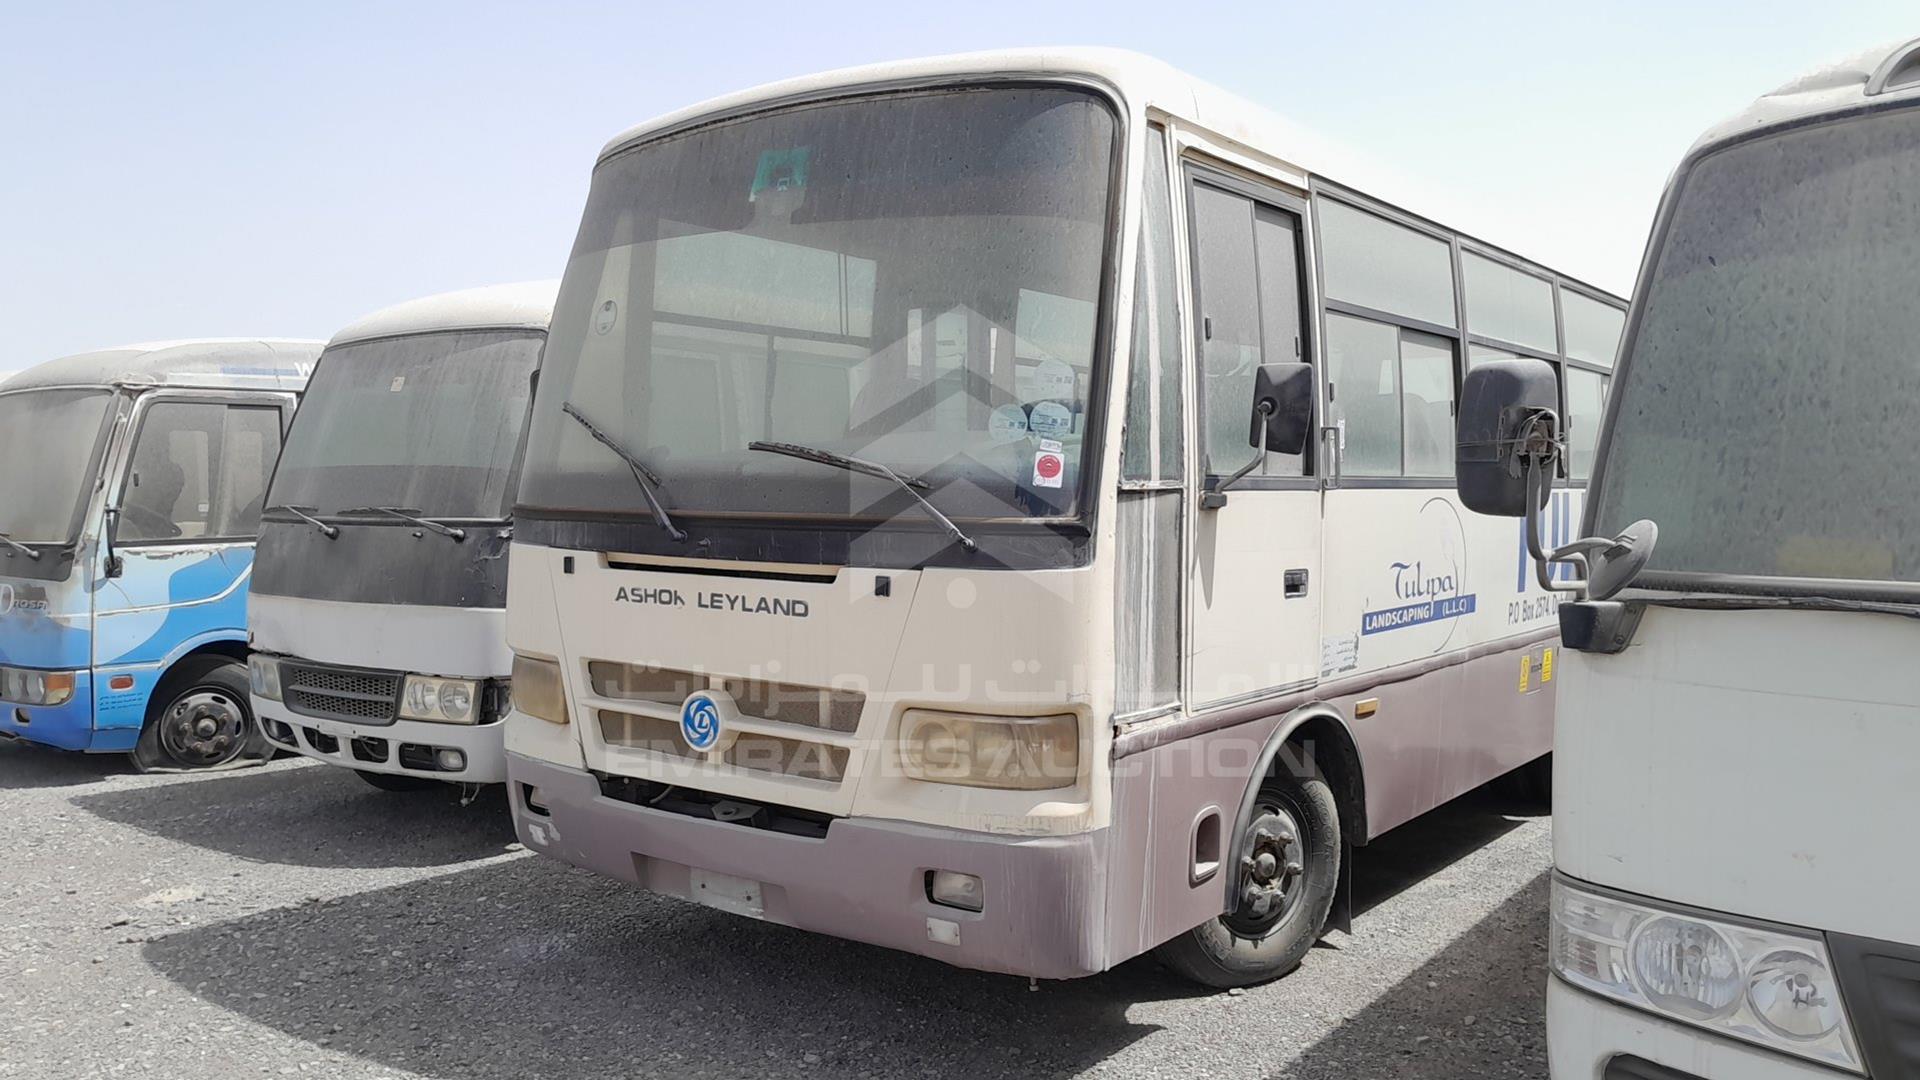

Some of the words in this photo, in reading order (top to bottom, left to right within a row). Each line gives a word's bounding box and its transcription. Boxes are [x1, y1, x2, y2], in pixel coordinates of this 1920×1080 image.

[697, 592, 809, 618] LEYLAND
[1522, 600, 1534, 622] Box
[1365, 606, 1430, 631] LANDSCAPING
